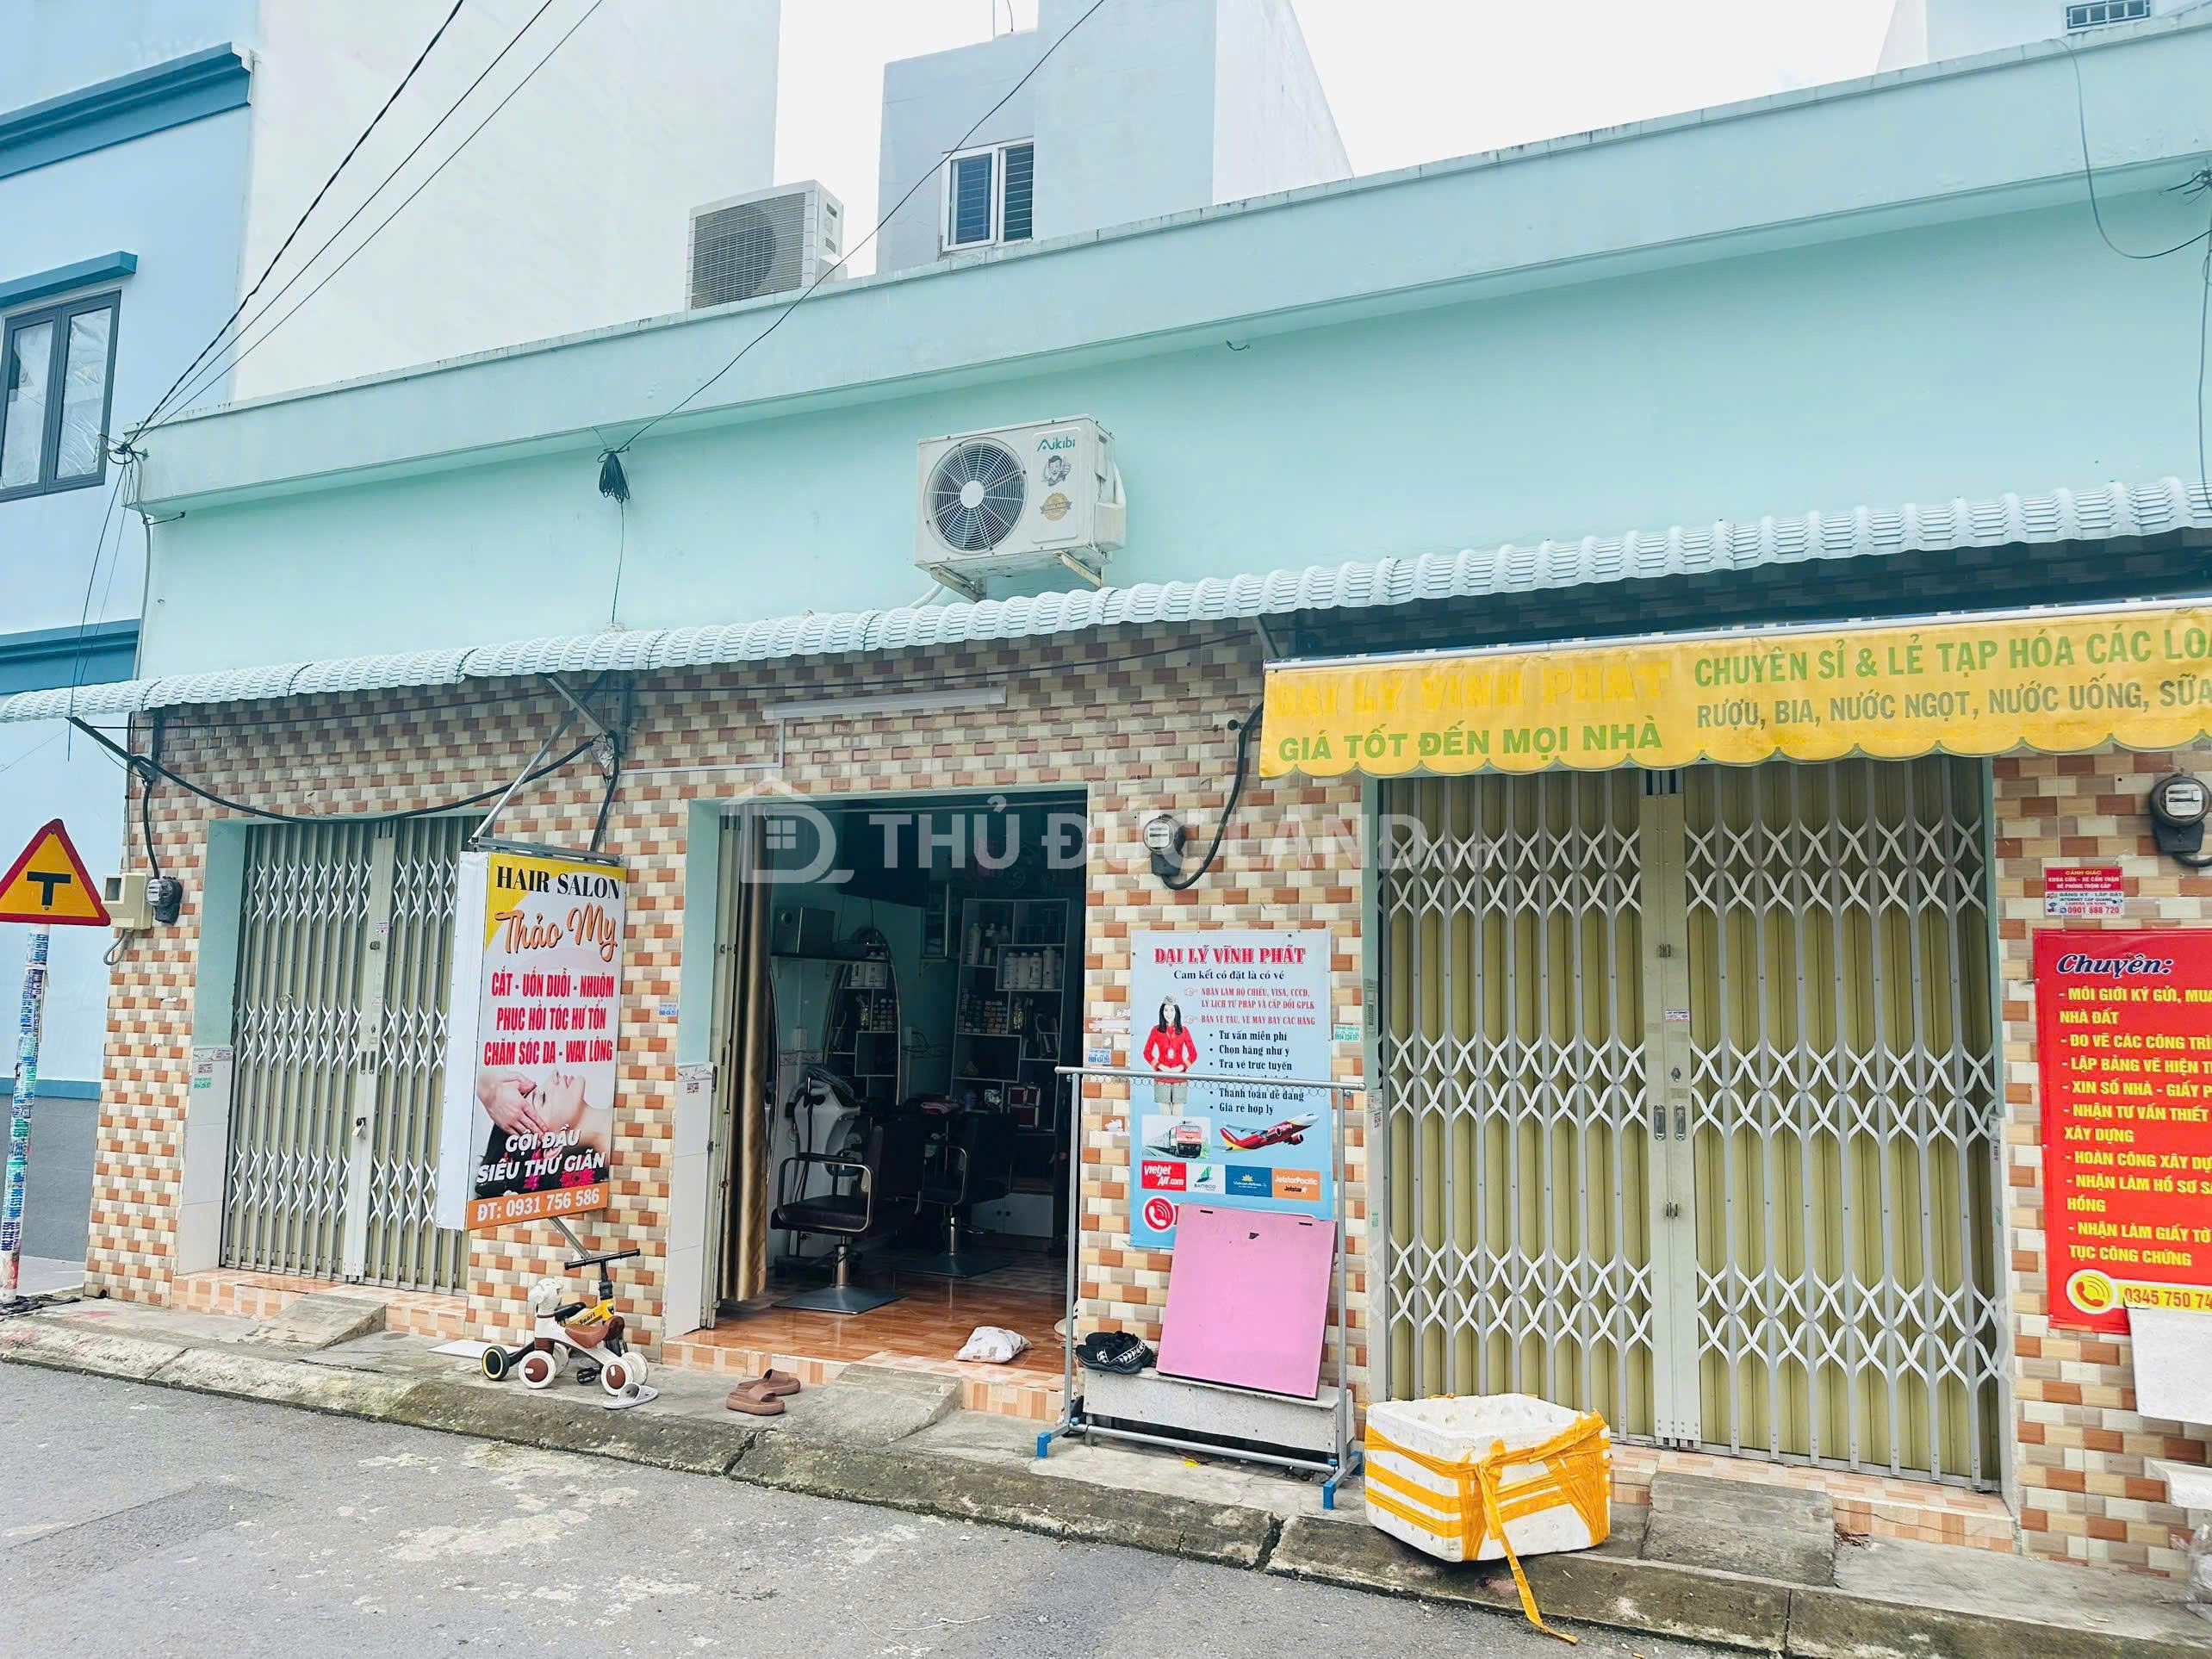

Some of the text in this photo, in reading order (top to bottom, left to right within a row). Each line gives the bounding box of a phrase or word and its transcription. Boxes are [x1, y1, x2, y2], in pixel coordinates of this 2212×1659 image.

[1694, 624, 2212, 687] CHUYÊN SỈ & LẺ TẠP HÓA CÁC LO
[1697, 673, 2212, 730] RƯỢU, BIA, NƯỚC NGỌT, NƯỚC UỐNG, SỮA
[1278, 716, 1662, 761] GIÁ TỐT ĐẾN MỌI NHÀ
[496, 866, 620, 898] HAIR SALON
[495, 902, 618, 962] Thảo My
[1154, 948, 1184, 966] ĐẠI
[1188, 945, 1209, 965] LÝ
[1213, 945, 1254, 965] VĨNH
[2057, 953, 2174, 979] Chuyên:
[492, 966, 513, 997] CẮT
[523, 966, 544, 997] UỐN
[546, 968, 570, 997] DUỖI
[1174, 968, 1284, 981] Cam kết có đặt là có vé
[2068, 986, 2095, 1001] MÔI
[2099, 986, 2127, 1002] GIỚI
[2131, 986, 2149, 1002] KÝ
[2153, 985, 2182, 1003] GỬI,
[496, 999, 606, 1035] PHỤC HỒI TÓC HƯ TỔN
[2060, 1007, 2119, 1024] NHÀ ĐẤT
[484, 1036, 613, 1066] CHĂM SÓC DA WAX LÔNG
[2070, 1035, 2089, 1047] ĐO
[2092, 1033, 2109, 1047] VẼ
[2114, 1033, 2142, 1048] CÁC
[2146, 1034, 2185, 1049] CÔNG
[2071, 1053, 2198, 1076] LẬP BẢNG VẼ HIỆN
[2072, 1081, 2097, 1093] XIN
[2100, 1078, 2120, 1095] SỐ
[2122, 1081, 2153, 1096] NHÀ
[2166, 1079, 2198, 1097] GIẤY
[2072, 1103, 2209, 1122] NHẬN TƯ VẤN THIẾT
[505, 1124, 581, 1156] GỘI ĐẦU
[2064, 1125, 2134, 1144] XÂY DỰNG
[476, 1149, 606, 1183] SIÊU THƯ GIÃN
[2074, 1150, 2113, 1165] HOÀN
[2117, 1151, 2156, 1168] CÔNG
[2159, 1153, 2188, 1169] XÂY
[2076, 1173, 2116, 1191] NHẬN
[2119, 1175, 2150, 1191] LÀM
[2177, 1179, 2196, 1194] SƠ
[477, 1188, 600, 1221] ĐT: 0931 756 586
[2078, 1221, 2117, 1239] NHẬN
[2122, 1223, 2152, 1240] LÀM
[2155, 1224, 2188, 1241] GIẤY
[2069, 1245, 2191, 1266] TỤC CÔNG CHỨNG
[2124, 1288, 2159, 1305] 0345
[2164, 1291, 2190, 1308] 750
